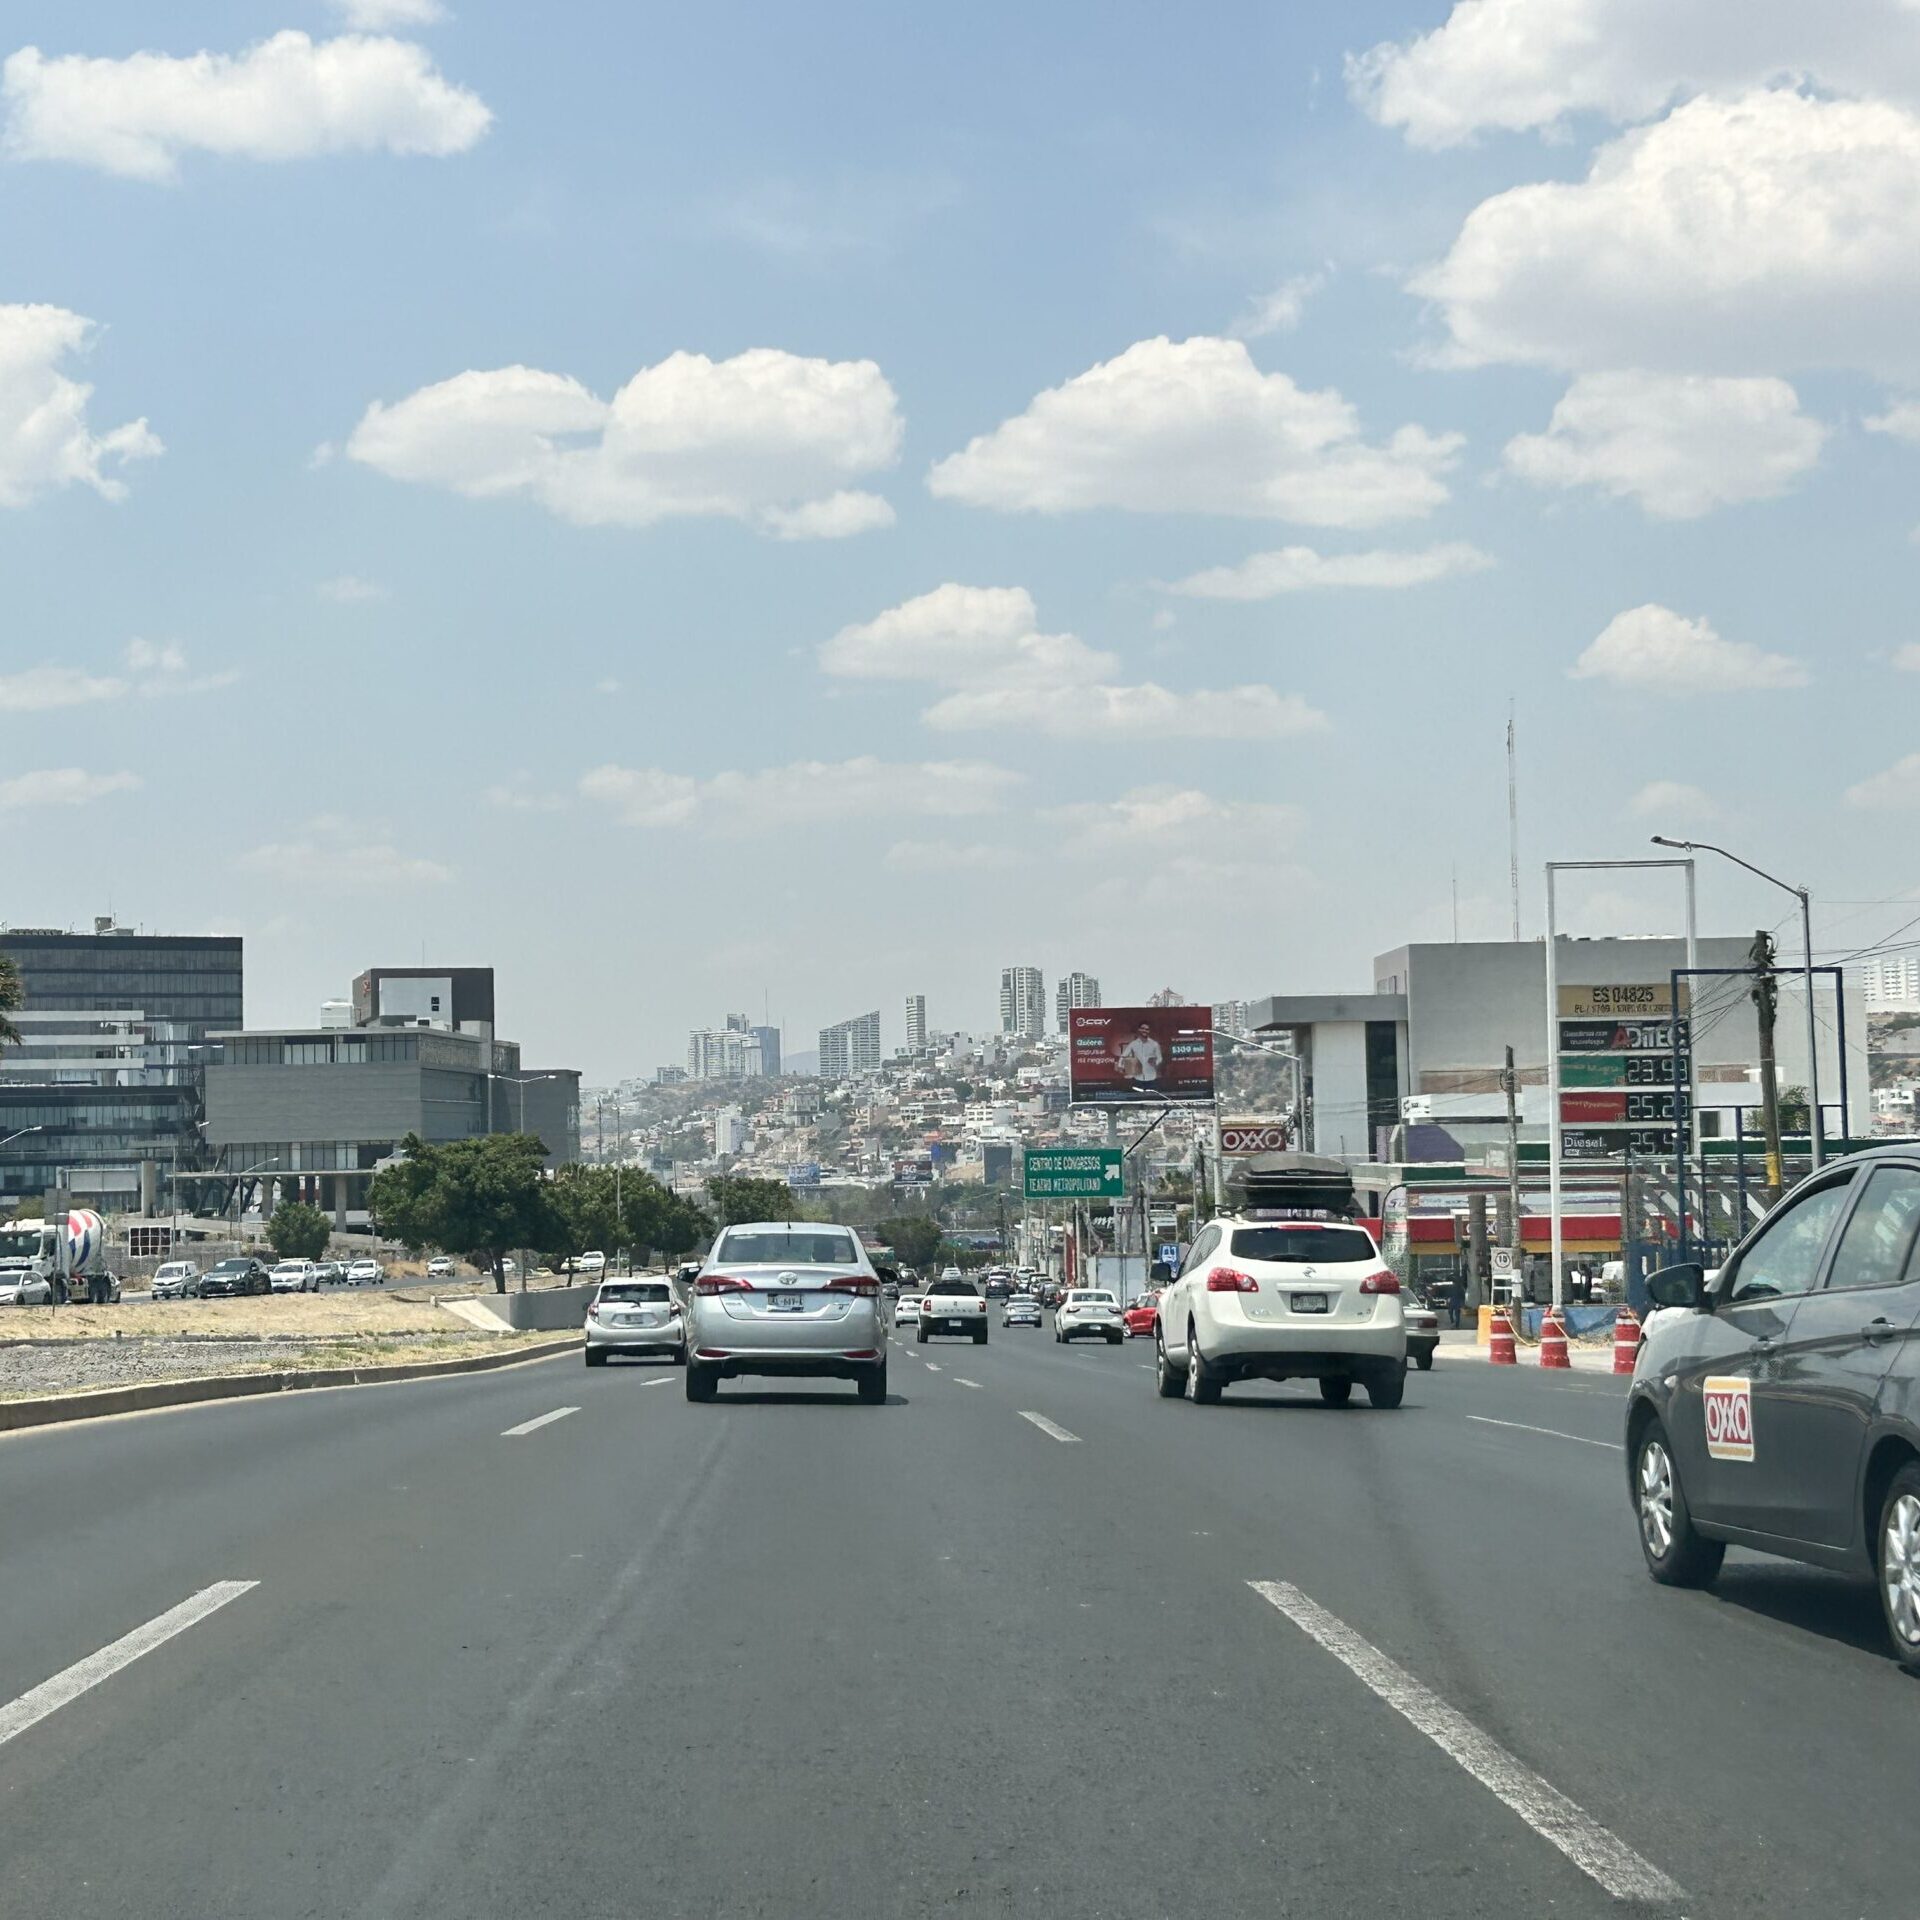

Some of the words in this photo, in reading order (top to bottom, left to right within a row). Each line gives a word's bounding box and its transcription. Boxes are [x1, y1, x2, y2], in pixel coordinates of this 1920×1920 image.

[1592, 987, 1609, 1003] ES
[1222, 1128, 1282, 1151] OXXO
[1564, 1136, 1603, 1148] Diesel
[1029, 1157, 1053, 1171] CENTRO
[1054, 1157, 1062, 1171] DE
[1063, 1156, 1101, 1171] CONGRESOS
[1029, 1178, 1052, 1191] TEATRO
[1053, 1177, 1101, 1191] METROPOLITANO
[1706, 1393, 1749, 1442] OXXO
